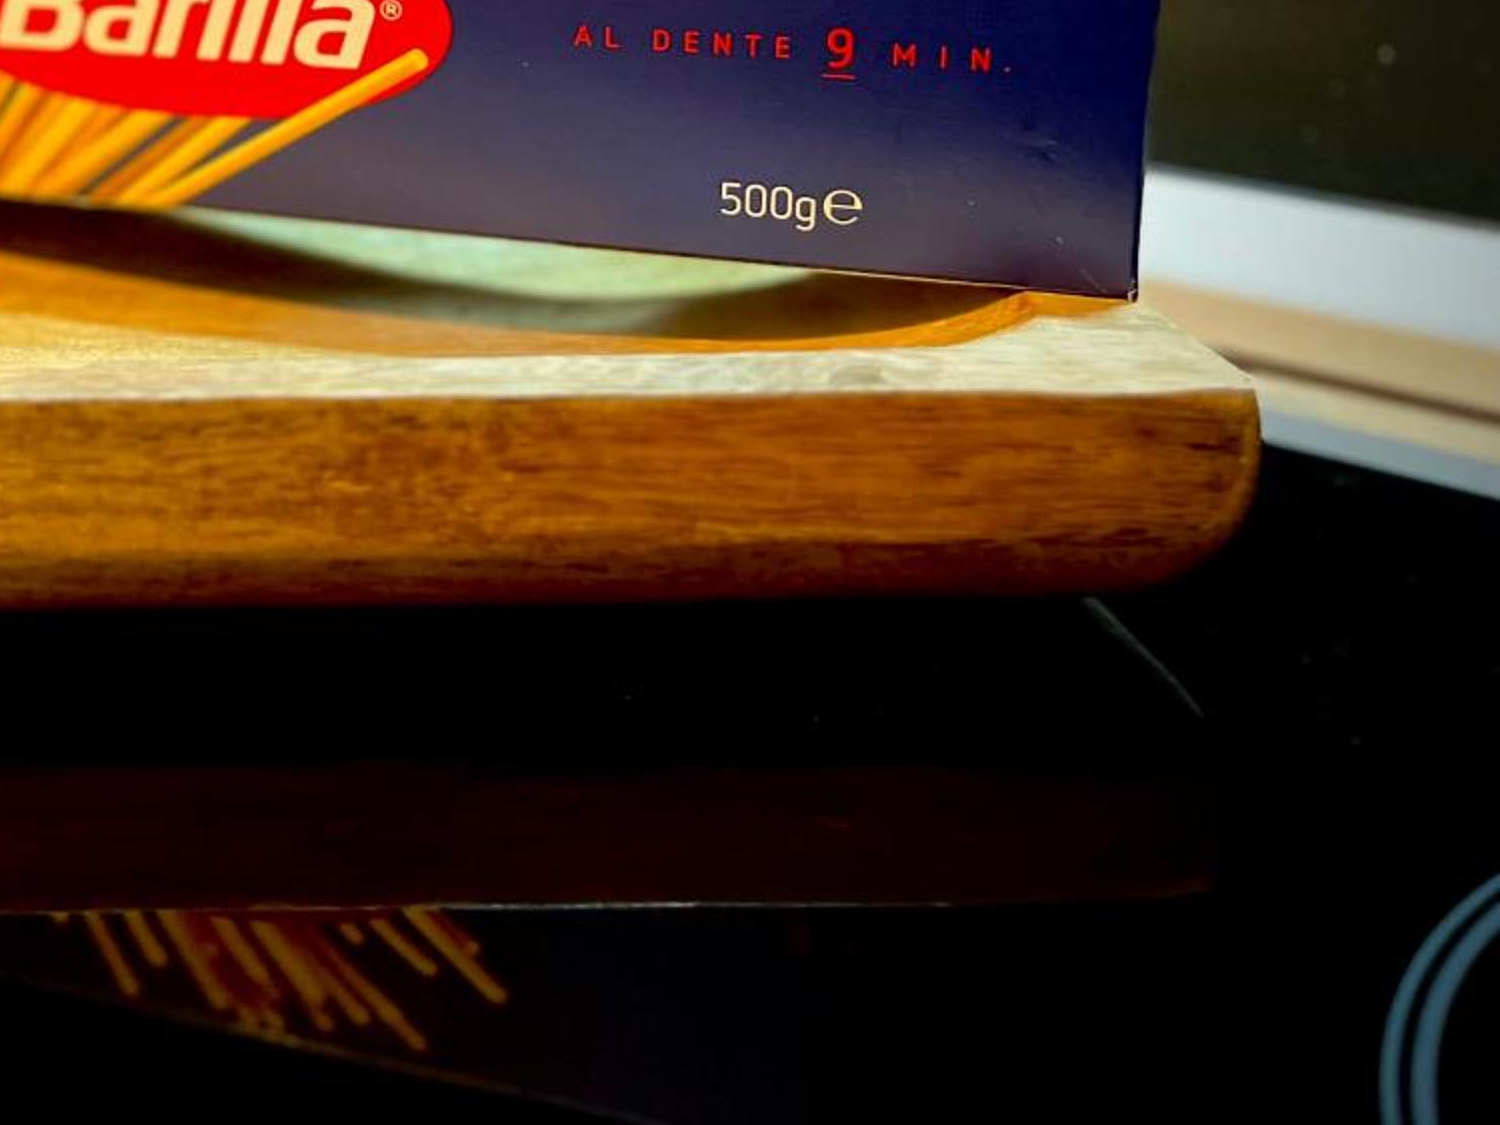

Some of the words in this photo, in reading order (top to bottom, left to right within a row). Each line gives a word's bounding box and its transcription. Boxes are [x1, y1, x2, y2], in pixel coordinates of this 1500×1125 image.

[572, 23, 620, 49] AL
[651, 28, 791, 60] DENTE
[826, 26, 856, 70] 9
[891, 42, 1013, 74] MIN.
